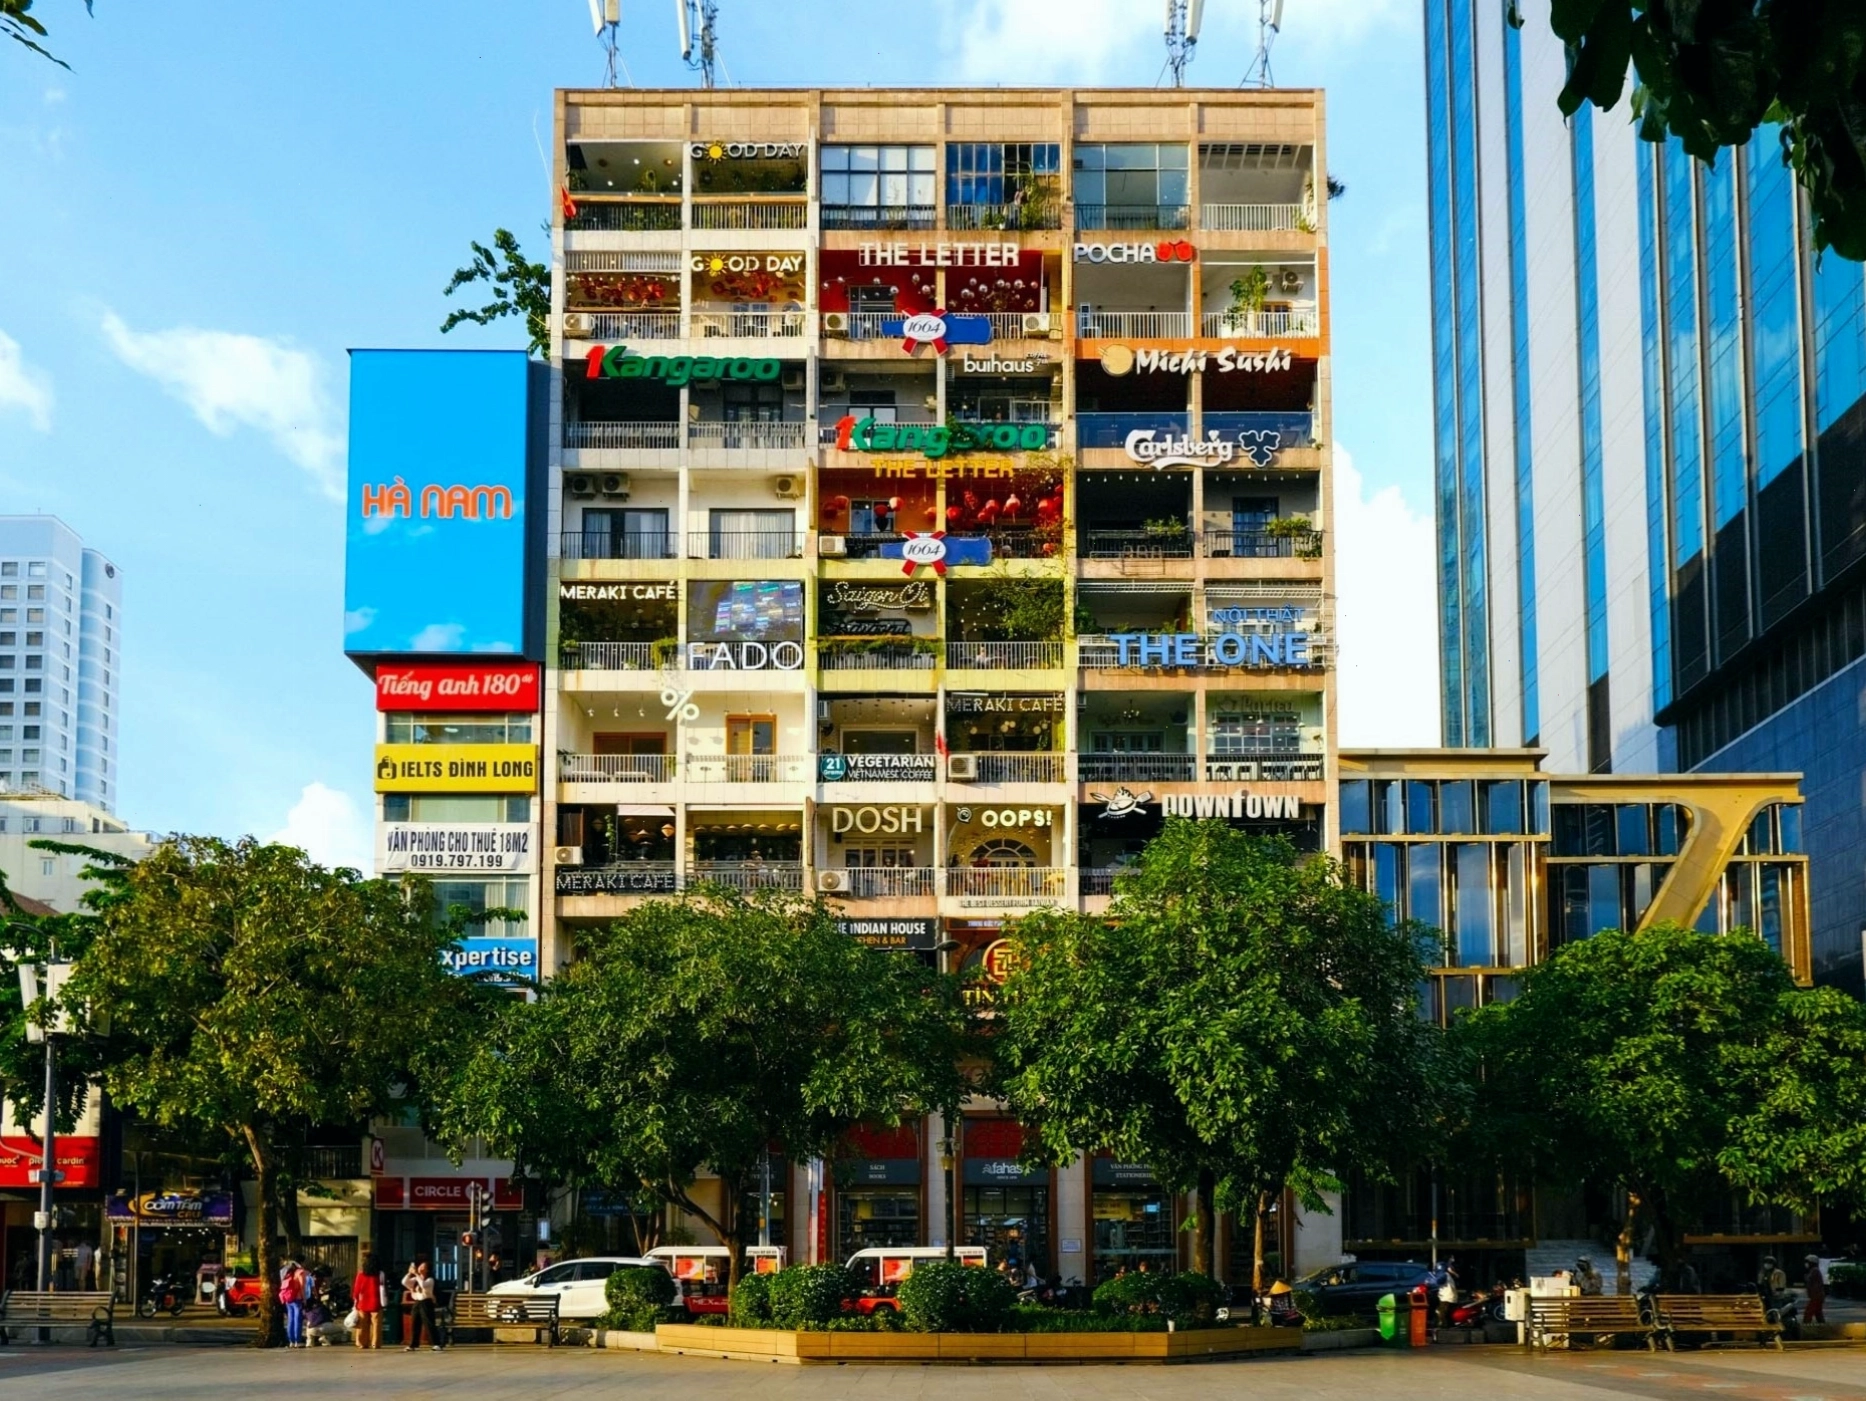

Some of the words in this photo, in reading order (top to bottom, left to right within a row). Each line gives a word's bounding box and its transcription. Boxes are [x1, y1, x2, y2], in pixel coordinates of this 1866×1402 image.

[764, 142, 805, 158] DAY
[861, 241, 909, 266] THE
[920, 242, 1019, 267] LETTER
[1073, 242, 1156, 263] POCHA
[766, 255, 803, 272] DAY
[907, 320, 942, 333] 1664
[1136, 347, 1207, 375] Michi
[1216, 346, 1291, 373] Sushi
[1125, 429, 1233, 466] Carlsberg
[871, 458, 916, 478] THE
[926, 458, 1014, 478] LETTER
[362, 475, 412, 519] HÀ
[907, 542, 942, 556] 1664
[560, 585, 627, 600] MERAKI
[633, 581, 677, 600] CAFÉ
[827, 581, 899, 610] Saigon
[688, 641, 803, 670] FADO
[1109, 633, 1199, 667] THE
[1214, 632, 1309, 667] ONE
[377, 670, 433, 701] Tiếng
[437, 674, 480, 695] anh
[946, 698, 1014, 711] MERAKI
[1020, 693, 1064, 711] CAFÉ
[401, 761, 442, 778] IELTS
[449, 758, 487, 778] ĐÌNH
[493, 761, 533, 778] LONG
[826, 757, 841, 769] 21
[847, 755, 934, 768] VEGETARIAN
[847, 768, 899, 779] VIETNAMESE
[901, 768, 933, 779] COFFEE
[832, 806, 922, 834] DOSH
[981, 810, 1053, 827] OOPS!
[448, 832, 468, 853] CHO
[500, 831, 528, 853] 18M2
[411, 854, 503, 867] 0919.797.199
[556, 875, 626, 889] MERAKI
[849, 922, 888, 934] INDIAN
[890, 922, 926, 934] HOUSE
[890, 936, 907, 944] BAR
[441, 947, 532, 971] xpertise
[57, 1157, 85, 1165] cardin
[414, 1185, 461, 1197] CIRCLE
